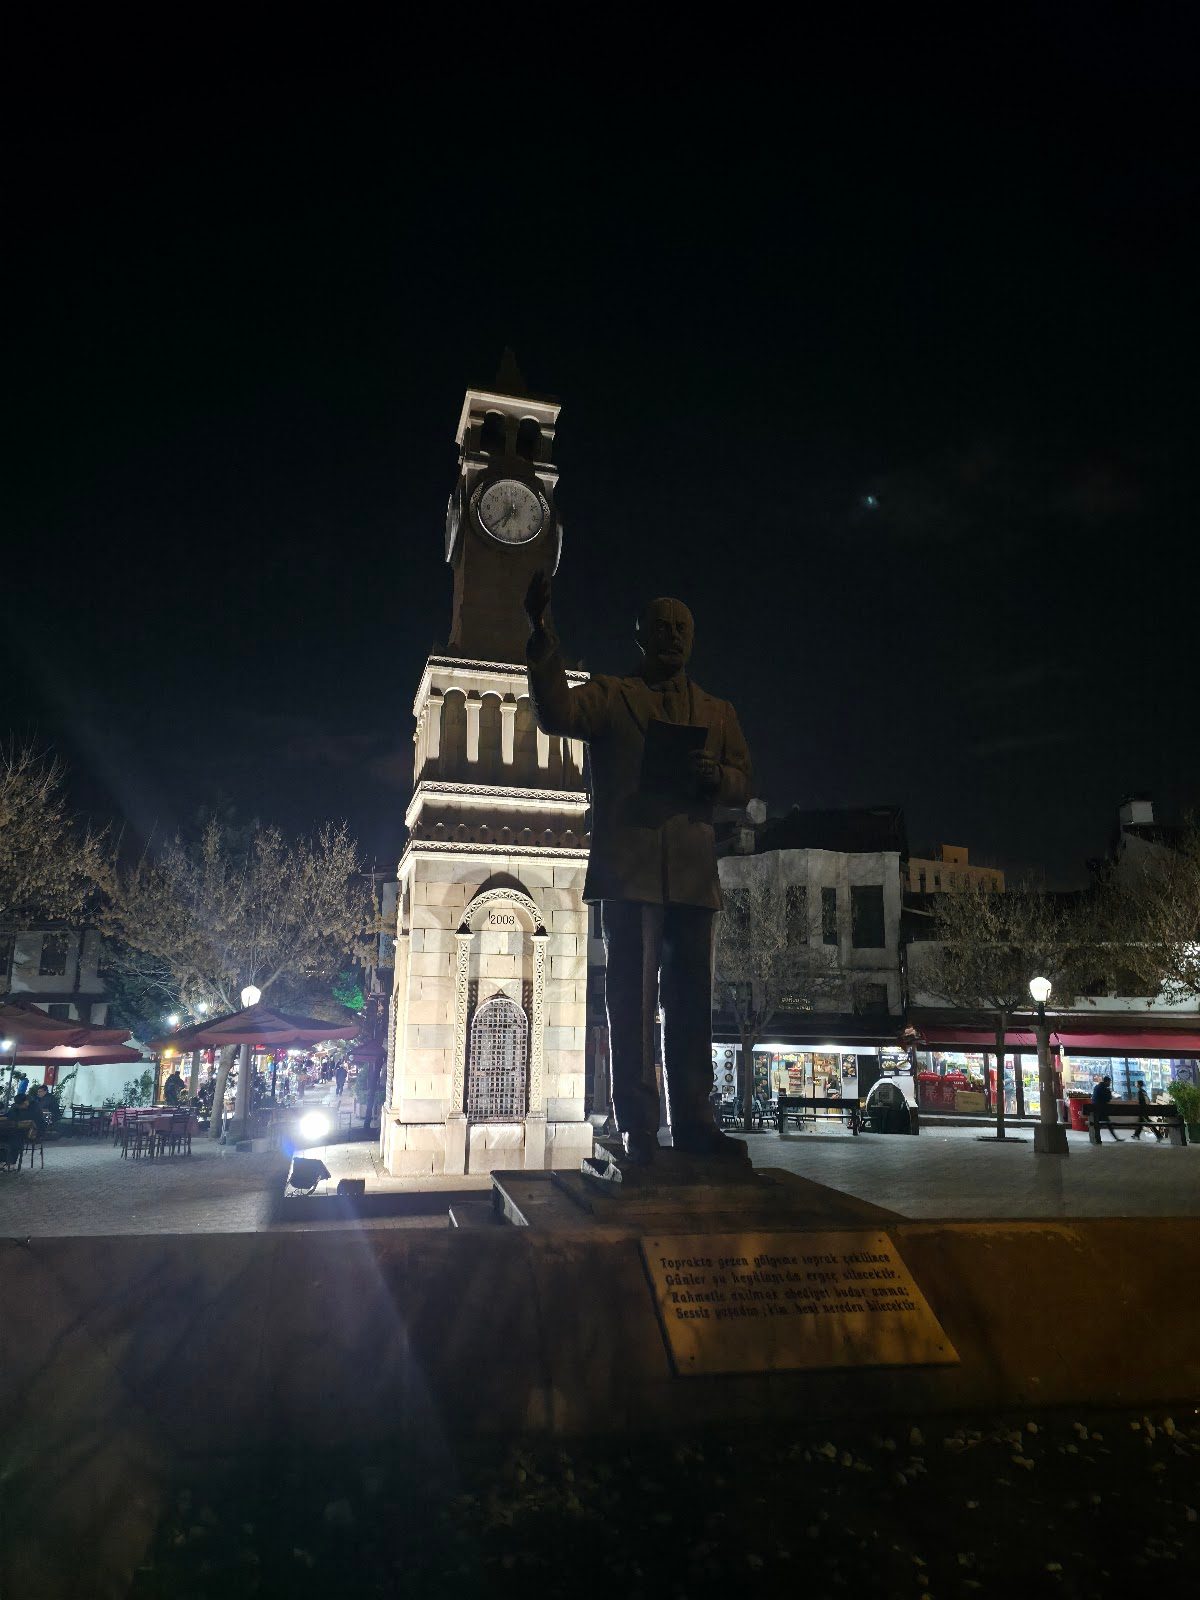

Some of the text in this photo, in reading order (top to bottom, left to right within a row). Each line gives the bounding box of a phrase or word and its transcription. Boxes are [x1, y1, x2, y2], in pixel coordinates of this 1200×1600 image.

[490, 914, 515, 925] 2008
[718, 1257, 749, 1270] gezen
[665, 1273, 706, 1285] Günler
[675, 1306, 710, 1319] Sessiz
[823, 1301, 865, 1313] nereden
